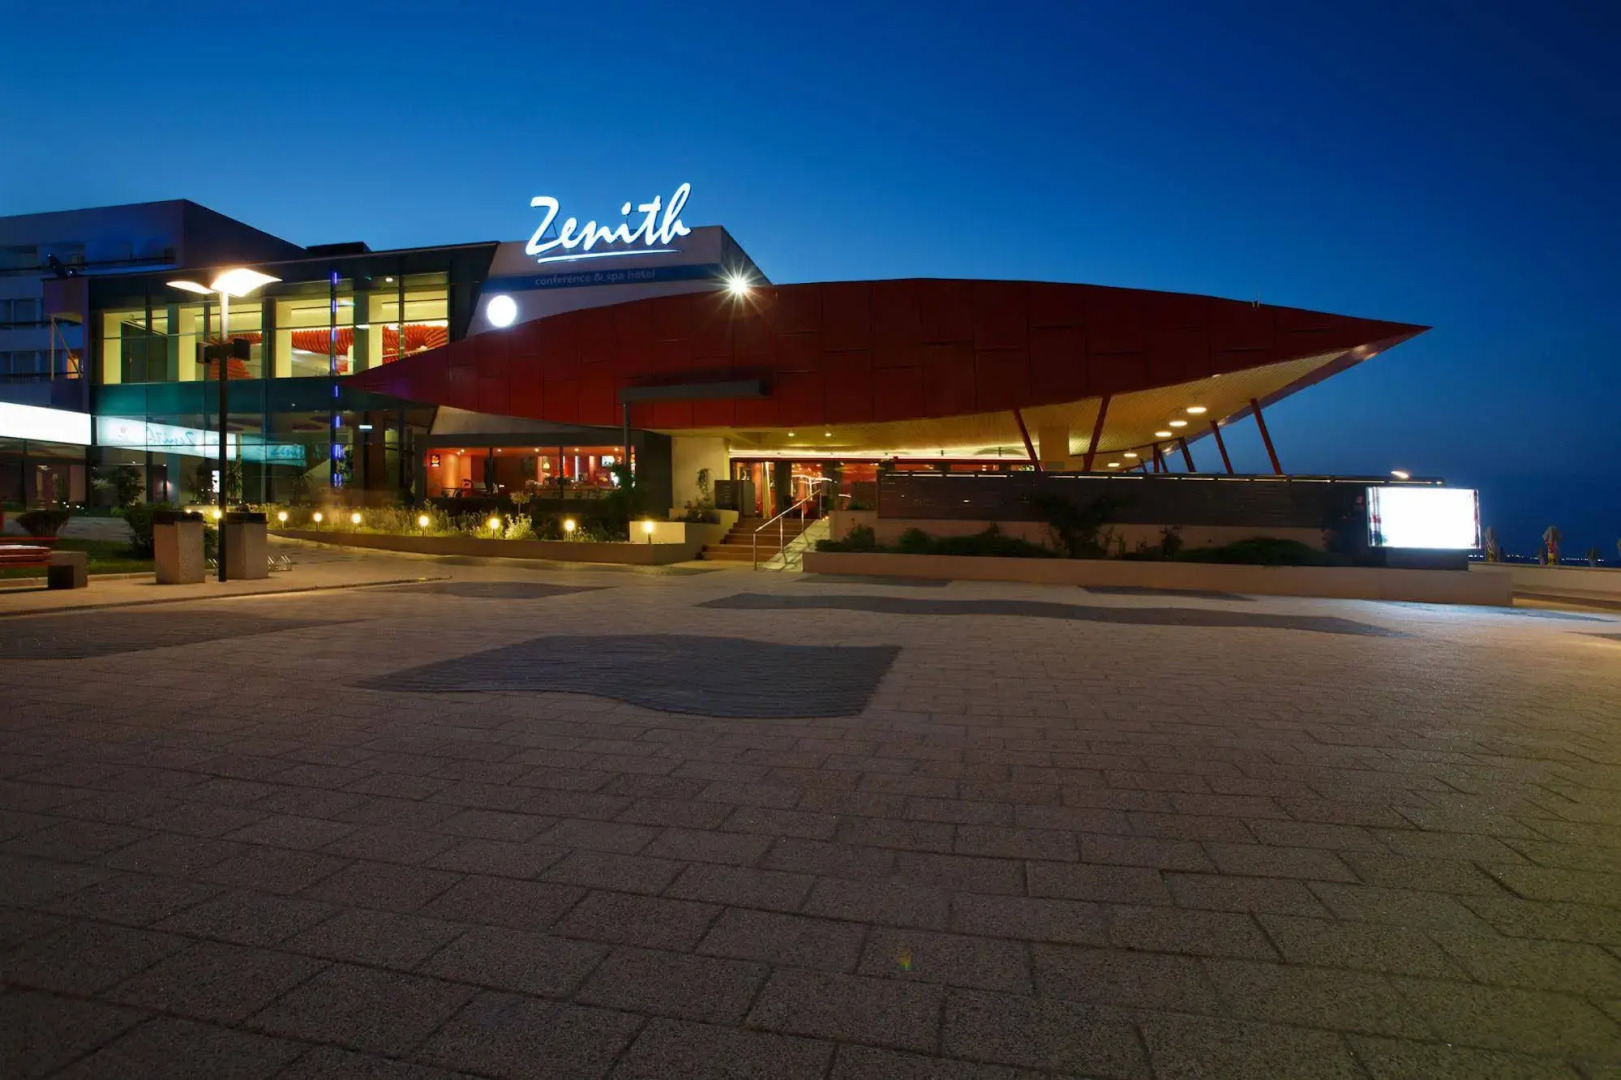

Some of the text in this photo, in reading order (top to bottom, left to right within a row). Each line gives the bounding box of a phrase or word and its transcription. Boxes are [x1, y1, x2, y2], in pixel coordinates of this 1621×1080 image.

[525, 182, 692, 256] Zenith
[535, 268, 656, 286] conference & spa hotel
